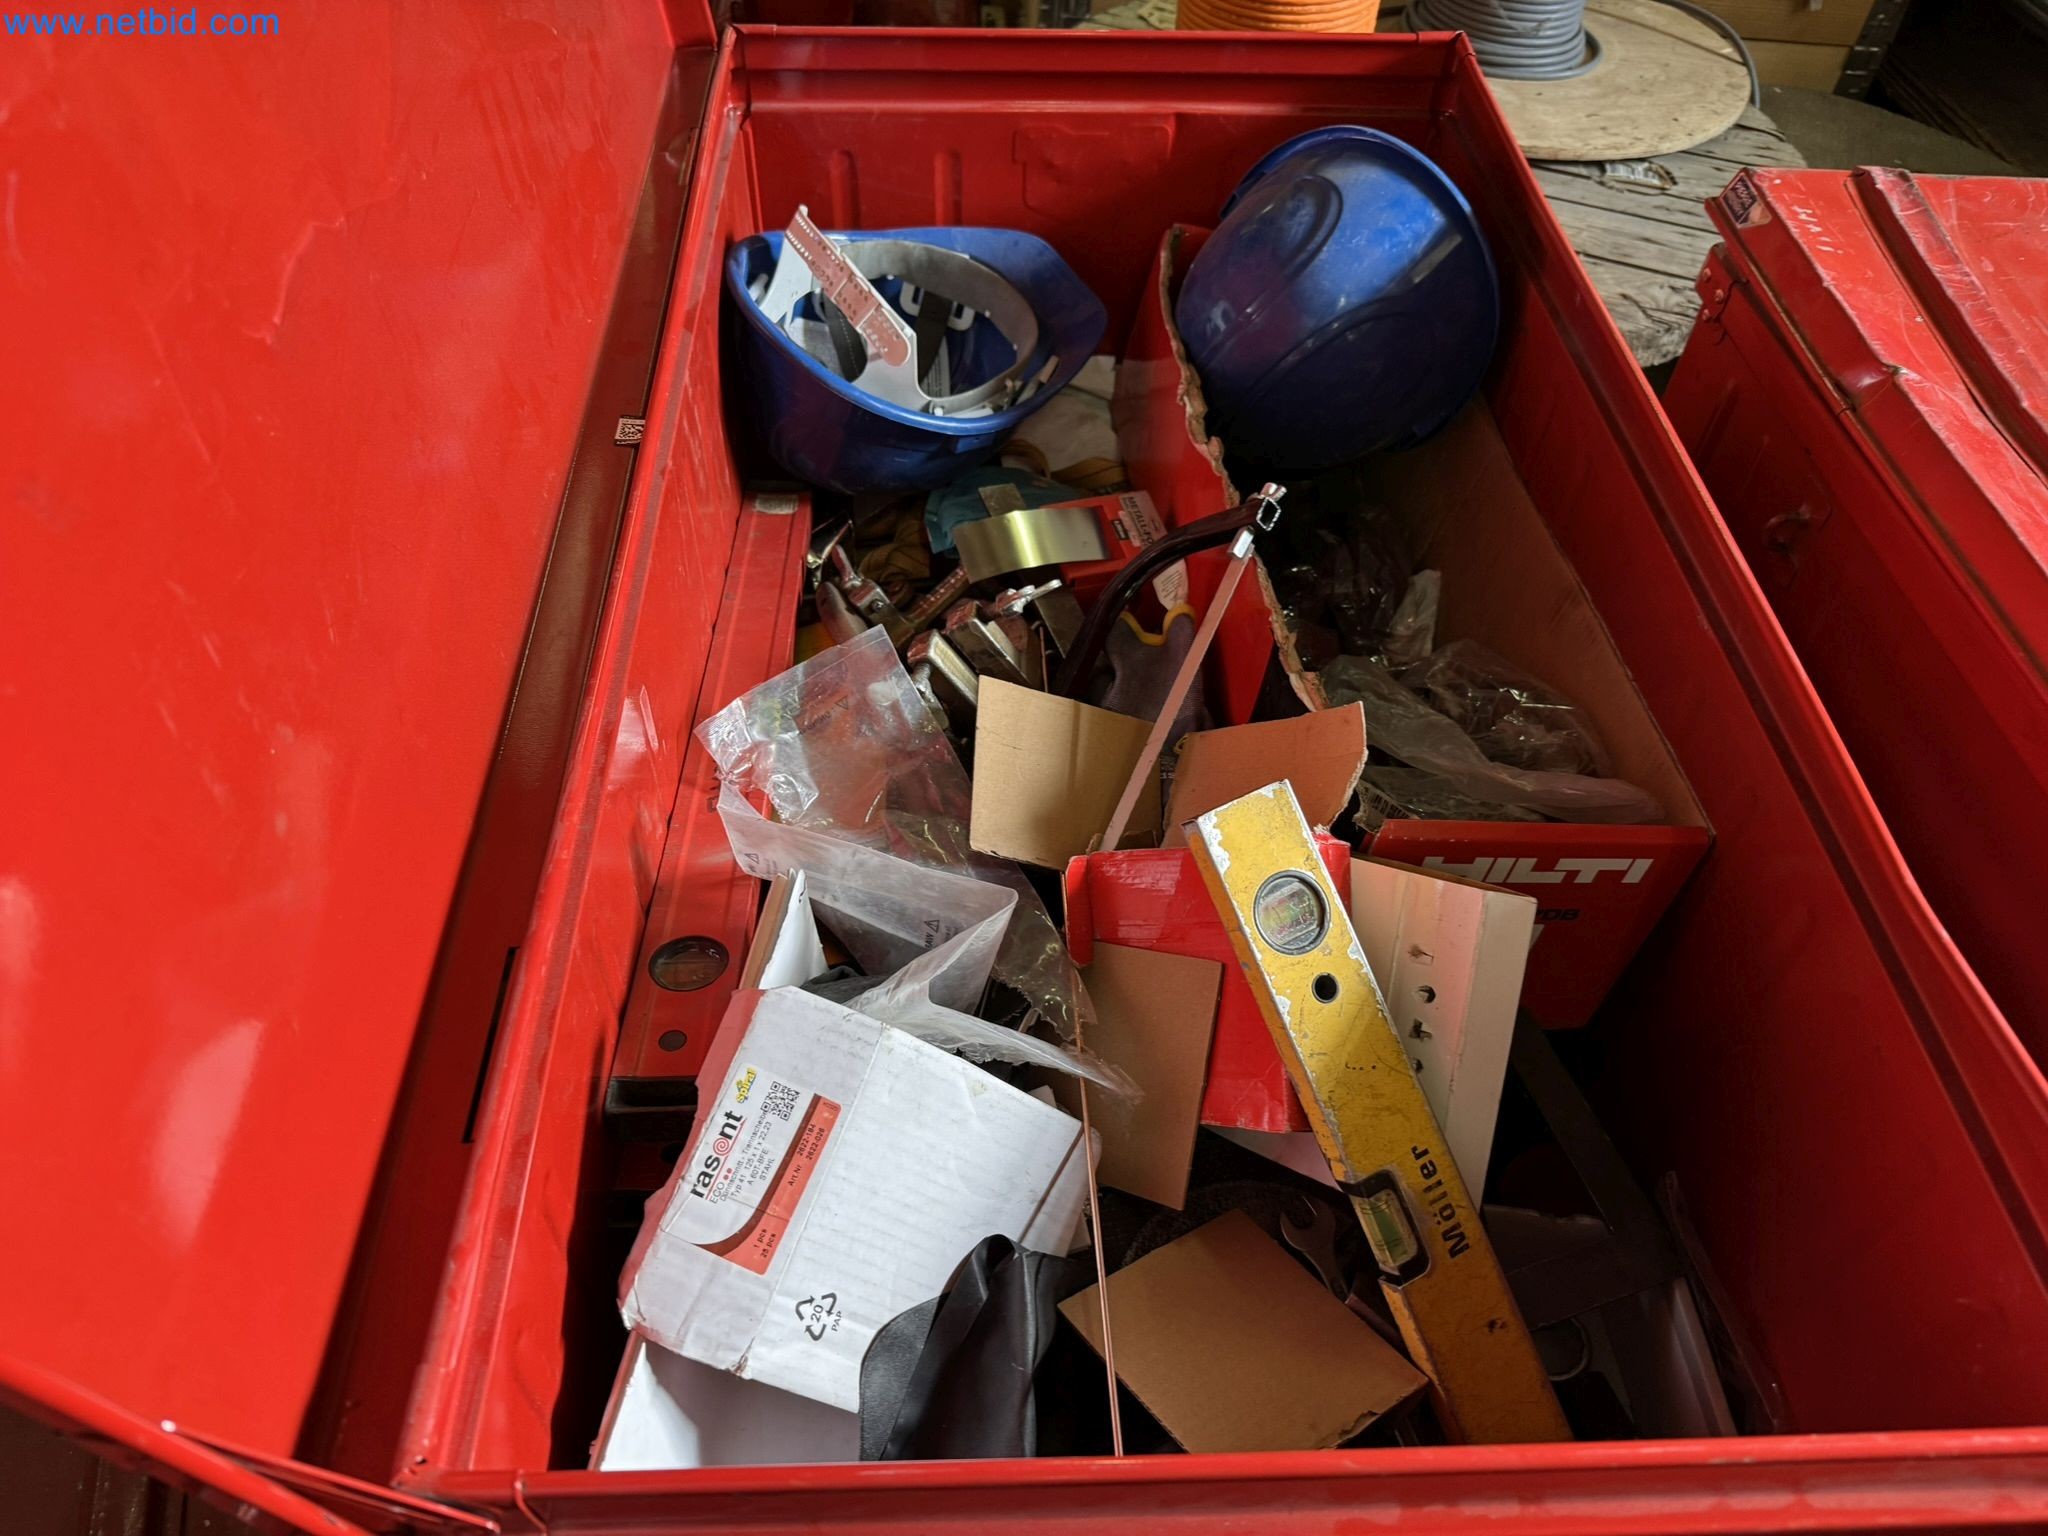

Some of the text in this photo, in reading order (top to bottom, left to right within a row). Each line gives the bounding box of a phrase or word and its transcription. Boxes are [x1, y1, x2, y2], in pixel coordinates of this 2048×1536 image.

[1420, 856, 1654, 884] HILTI
[690, 1109, 744, 1199] rasont
[731, 1183, 743, 1198] Typ
[738, 1174, 746, 1184] 41
[744, 1157, 754, 1170] 125
[759, 1157, 774, 1180] STAHL
[709, 1181, 725, 1204] ECO
[1411, 1145, 1470, 1258] Möller
[756, 1227, 768, 1243] pcs
[765, 1231, 777, 1247] pcs
[810, 1304, 824, 1323] 20
[831, 1310, 842, 1332] PAP
